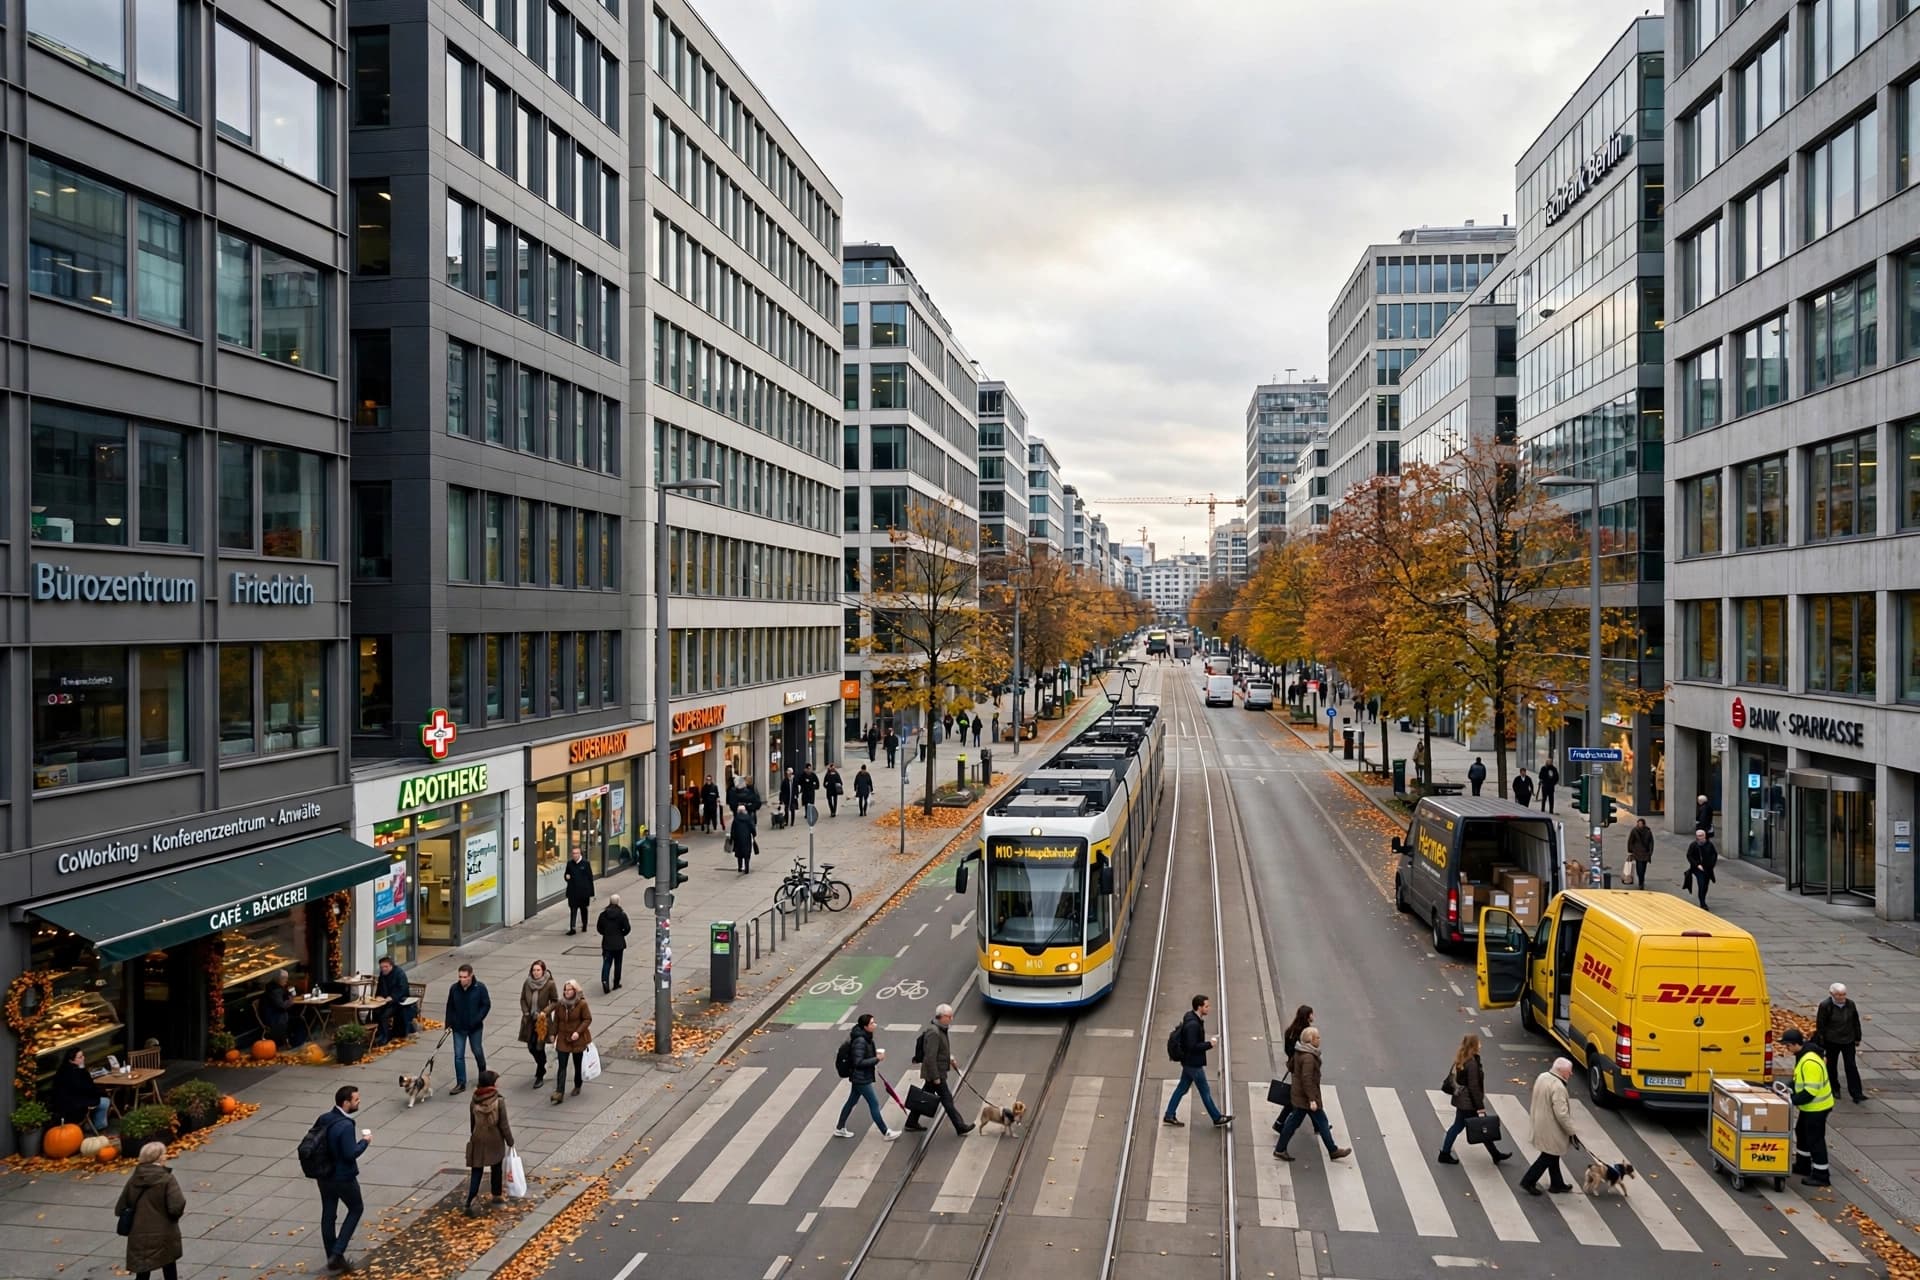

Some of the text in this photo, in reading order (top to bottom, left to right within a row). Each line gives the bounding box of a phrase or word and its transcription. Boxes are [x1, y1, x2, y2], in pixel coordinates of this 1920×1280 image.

[1588, 132, 1622, 185] Berlin
[34, 562, 314, 605] Bürozentrum Friedrich
[569, 730, 628, 763] SUPERMARKT
[1749, 706, 1864, 748] BANK SPARKASSE
[401, 764, 488, 810] APOTHEKE
[57, 802, 321, 874] CoWorking Konferenzzentrum Anwälte
[995, 845, 1013, 859] M10
[1418, 825, 1447, 869] Hermes
[210, 886, 308, 930] CAFÉ BÄCKEREI
[1025, 959, 1043, 969] M10
[1580, 952, 1615, 992] DHL
[1655, 983, 1741, 1005] DHL
